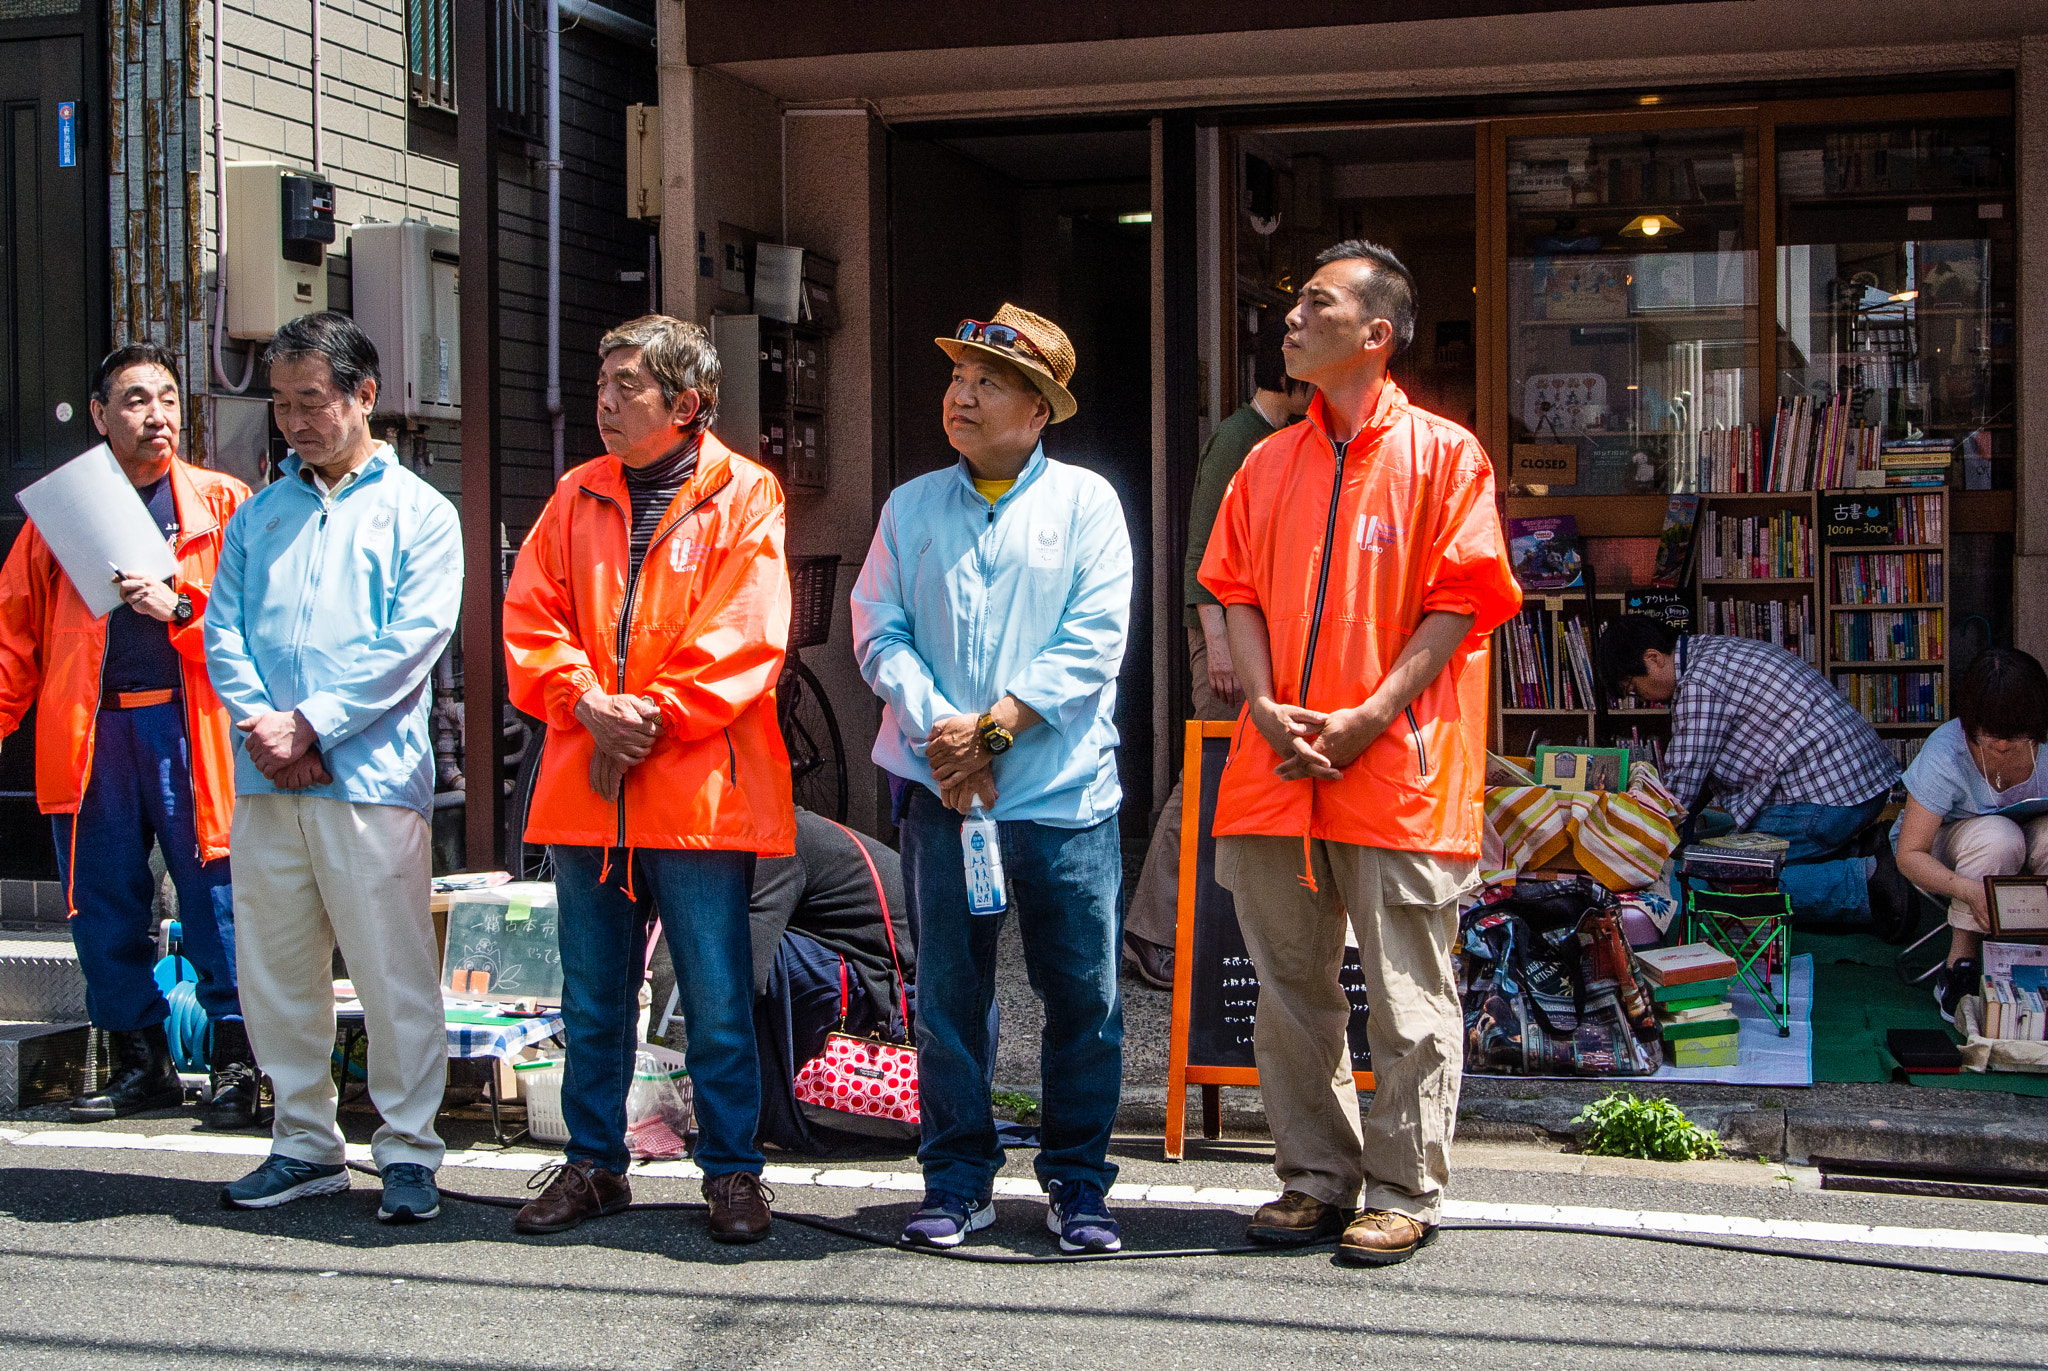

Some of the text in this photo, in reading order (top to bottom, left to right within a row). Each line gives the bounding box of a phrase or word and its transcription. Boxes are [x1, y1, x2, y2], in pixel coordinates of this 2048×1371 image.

[1521, 458, 1567, 470] CLOSED
[1833, 503, 1863, 520] 古書
[1644, 593, 1681, 604] アウトレット
